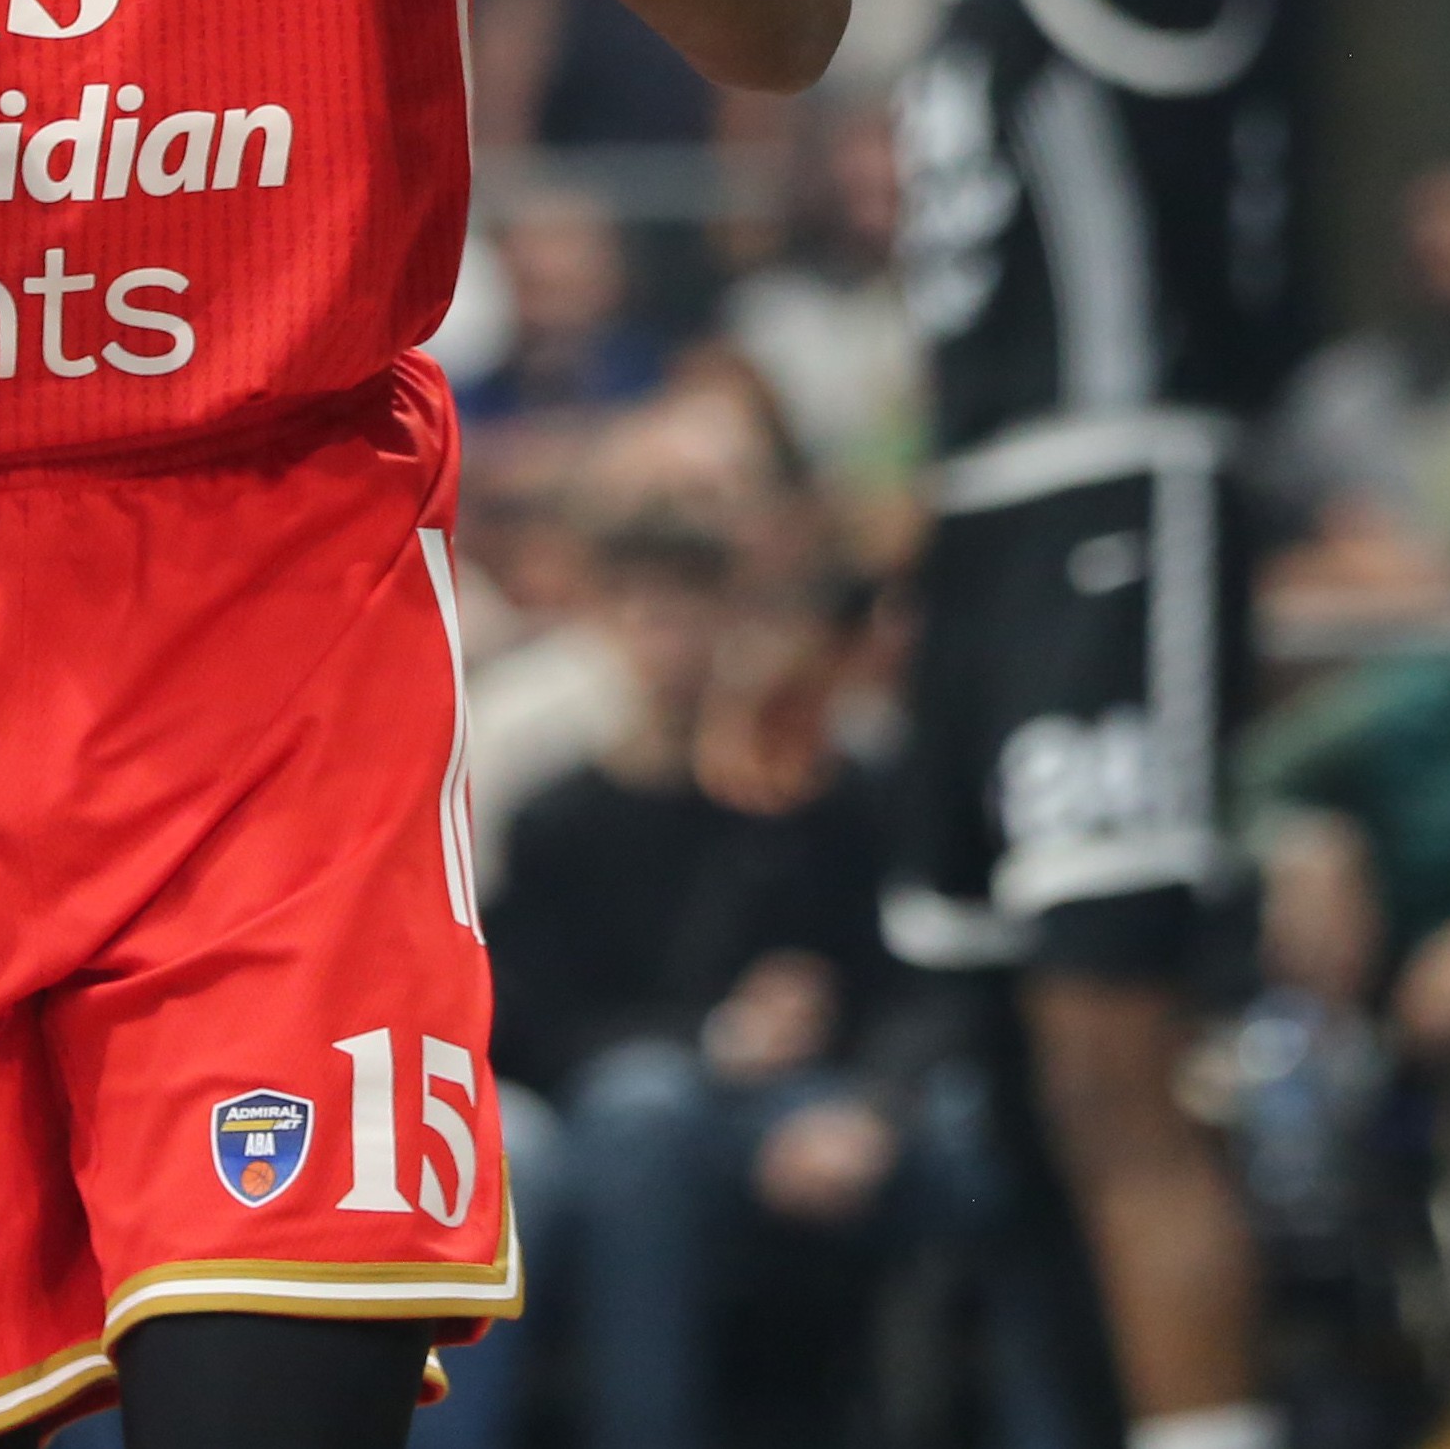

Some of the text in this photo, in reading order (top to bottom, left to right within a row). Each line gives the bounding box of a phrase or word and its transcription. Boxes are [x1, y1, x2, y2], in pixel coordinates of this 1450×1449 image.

[226, 1104, 303, 1121] ADMIRAL
[331, 1027, 477, 1229] 15
[244, 1132, 276, 1157] ABA
